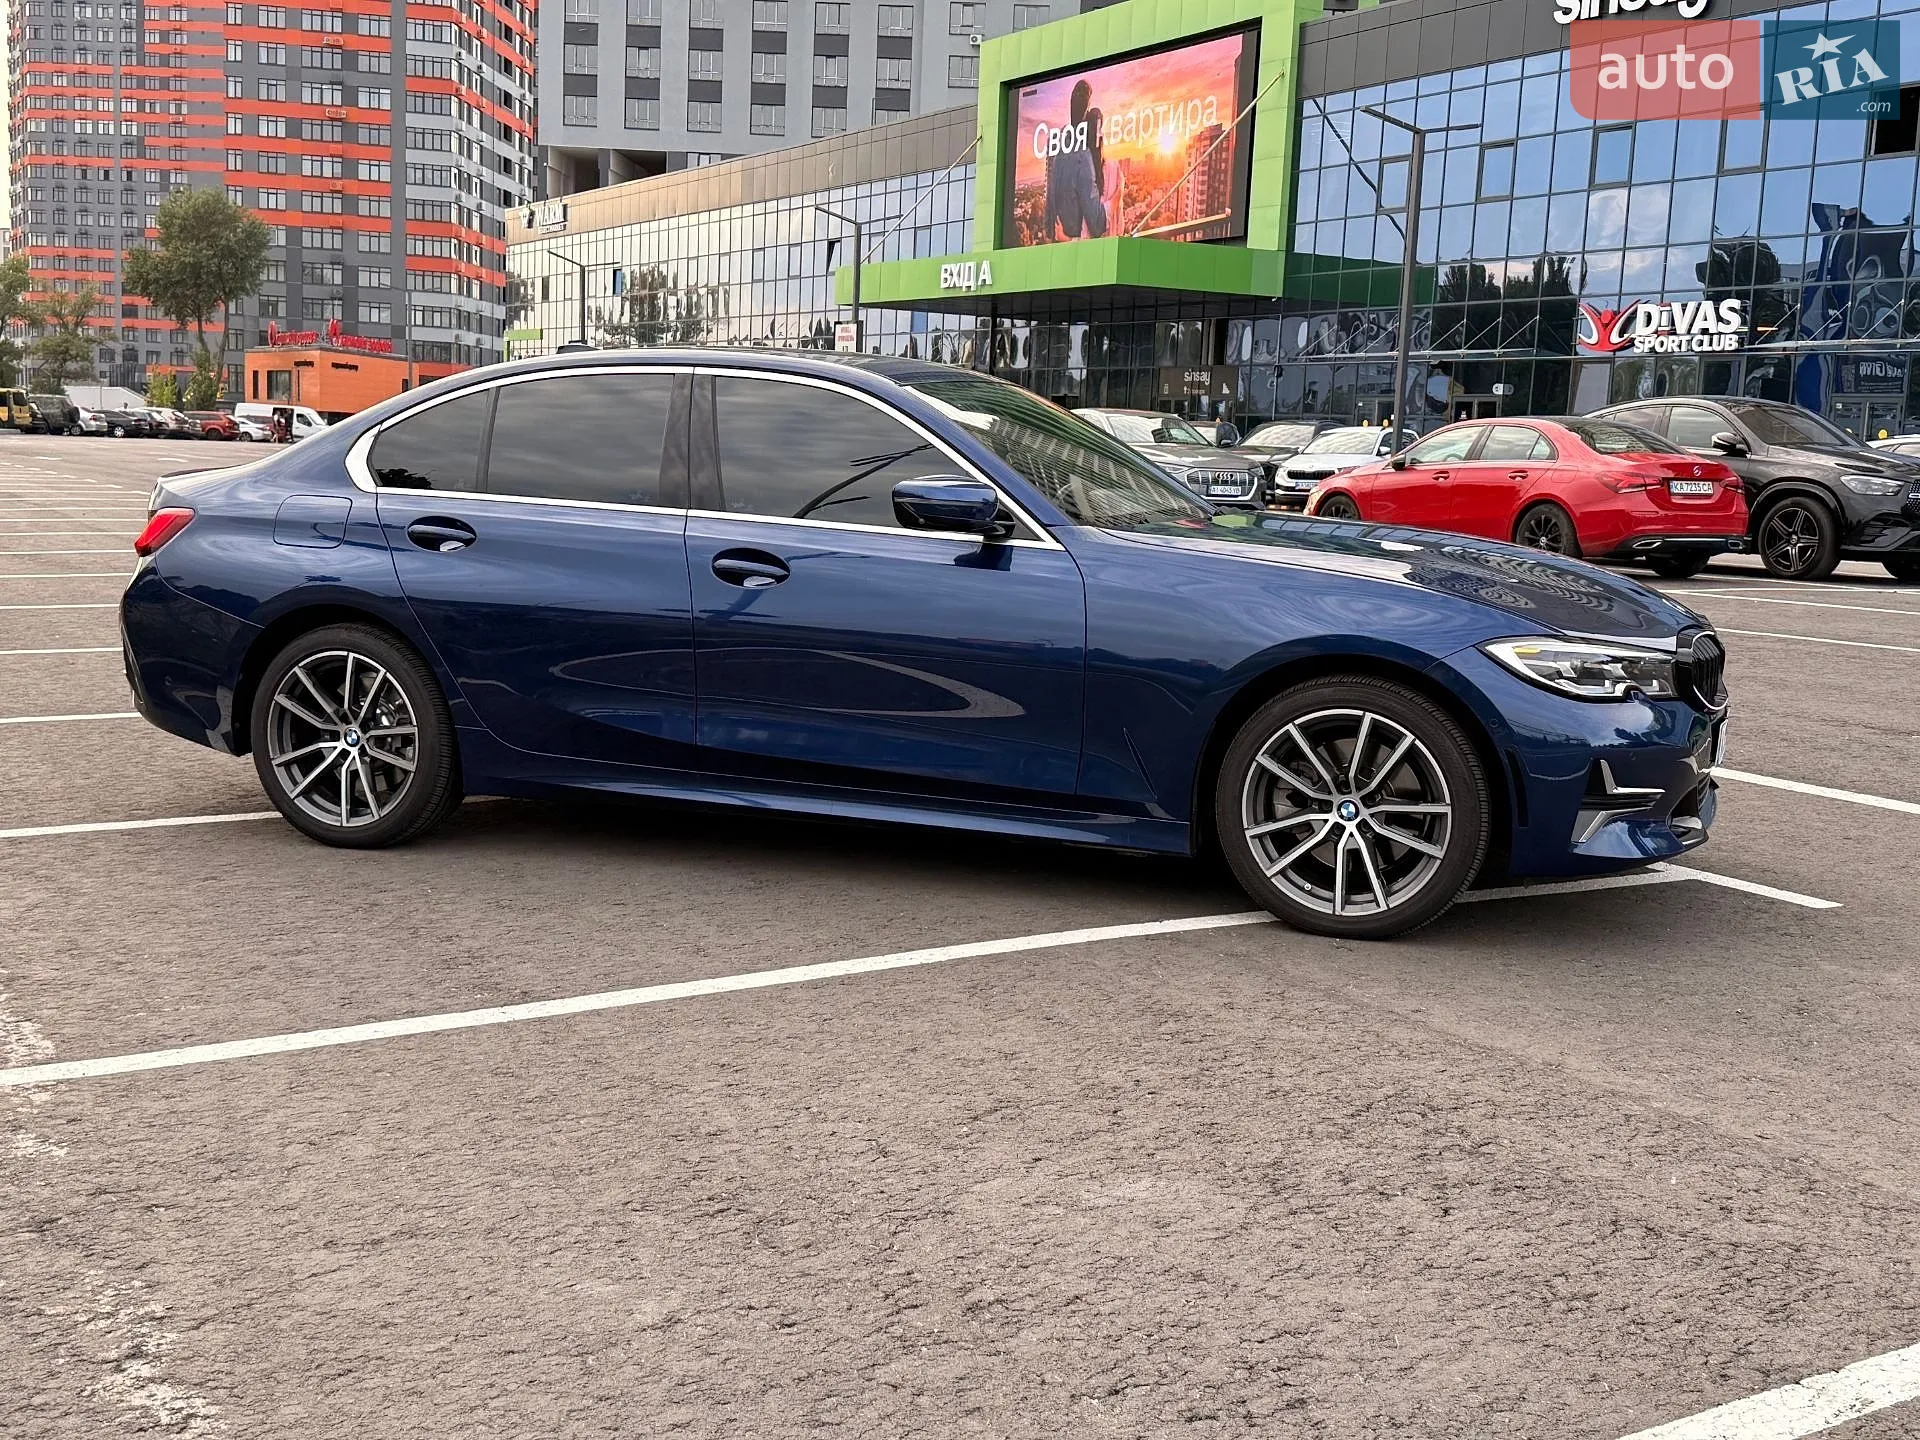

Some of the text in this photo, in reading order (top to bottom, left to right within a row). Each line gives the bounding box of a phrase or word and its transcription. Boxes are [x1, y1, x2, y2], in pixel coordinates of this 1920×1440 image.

[1033, 94, 1218, 160] Своя квартира
[940, 259, 993, 292] ВХІД А
[1633, 334, 1739, 353] SPORT CLUB
[1184, 369, 1211, 386] sinsay
